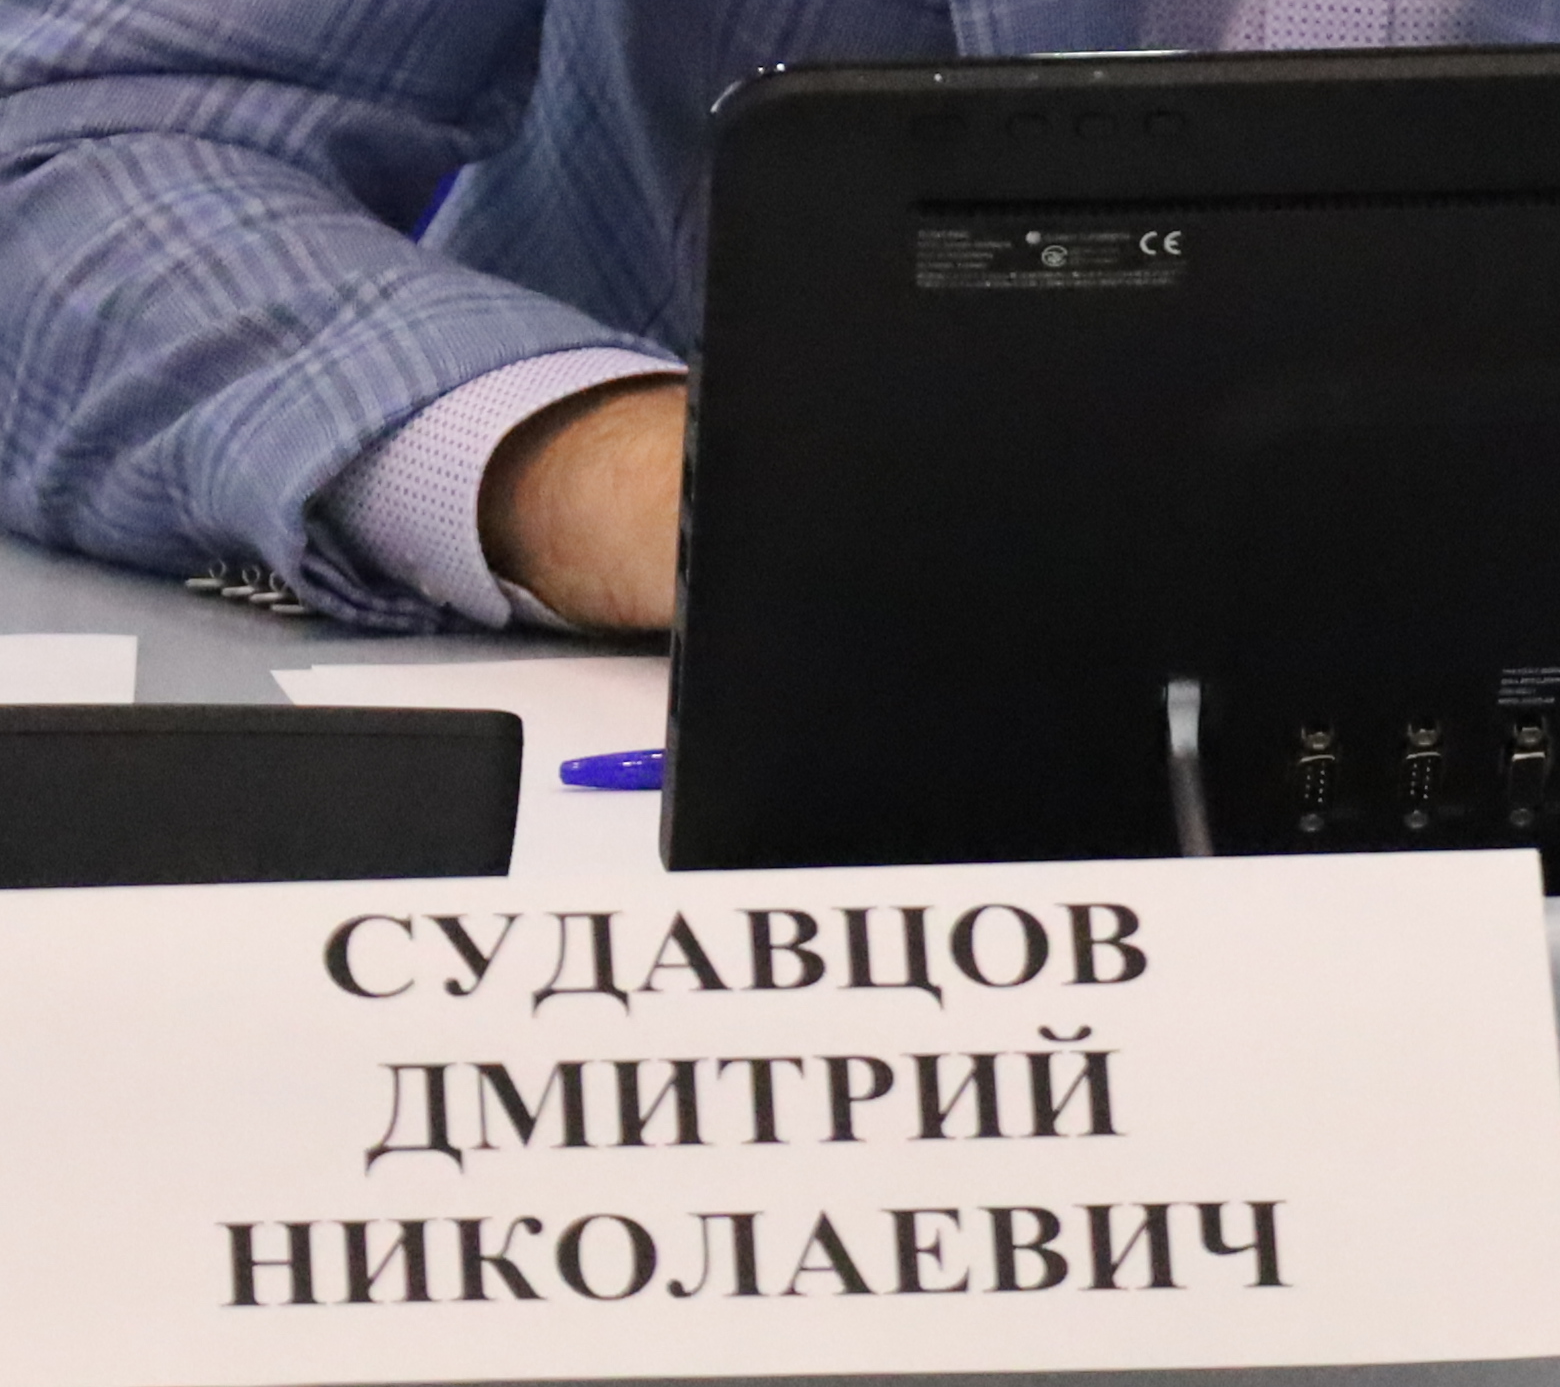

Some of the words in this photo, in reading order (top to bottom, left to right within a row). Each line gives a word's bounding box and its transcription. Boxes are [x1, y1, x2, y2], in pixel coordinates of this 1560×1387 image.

[323, 902, 1149, 1014] СУДАВЦОВ
[364, 1026, 1125, 1171] ДМИТРИЙ
[223, 1200, 1290, 1306] НИКОЛАЕВИЧ
